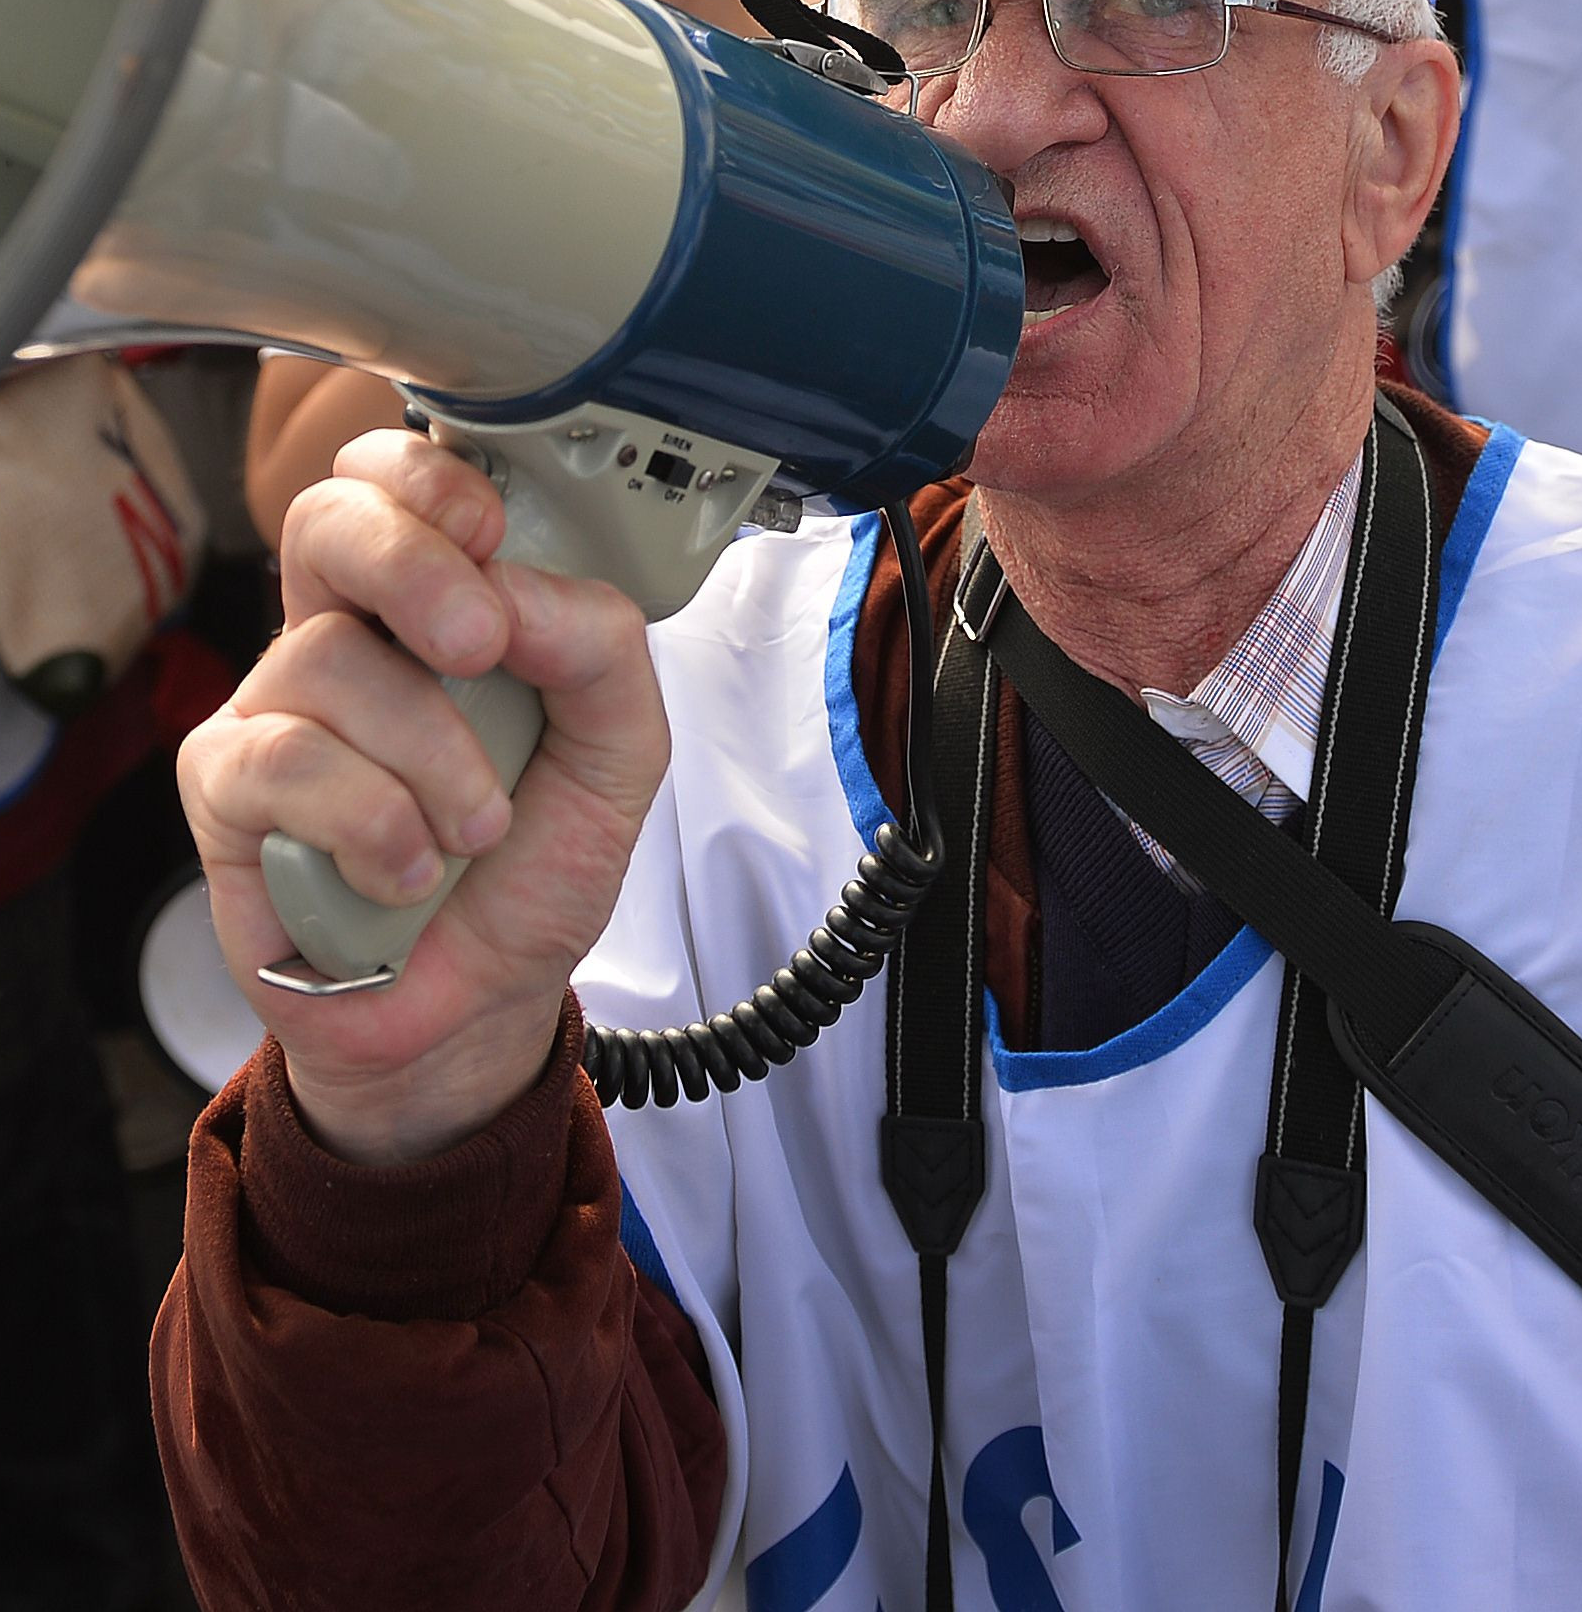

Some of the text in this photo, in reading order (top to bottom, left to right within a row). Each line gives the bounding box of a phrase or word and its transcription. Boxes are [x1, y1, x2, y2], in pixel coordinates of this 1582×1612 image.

[660, 433, 693, 453] SIREN
[627, 477, 644, 492] ON
[663, 488, 686, 506] OFF
